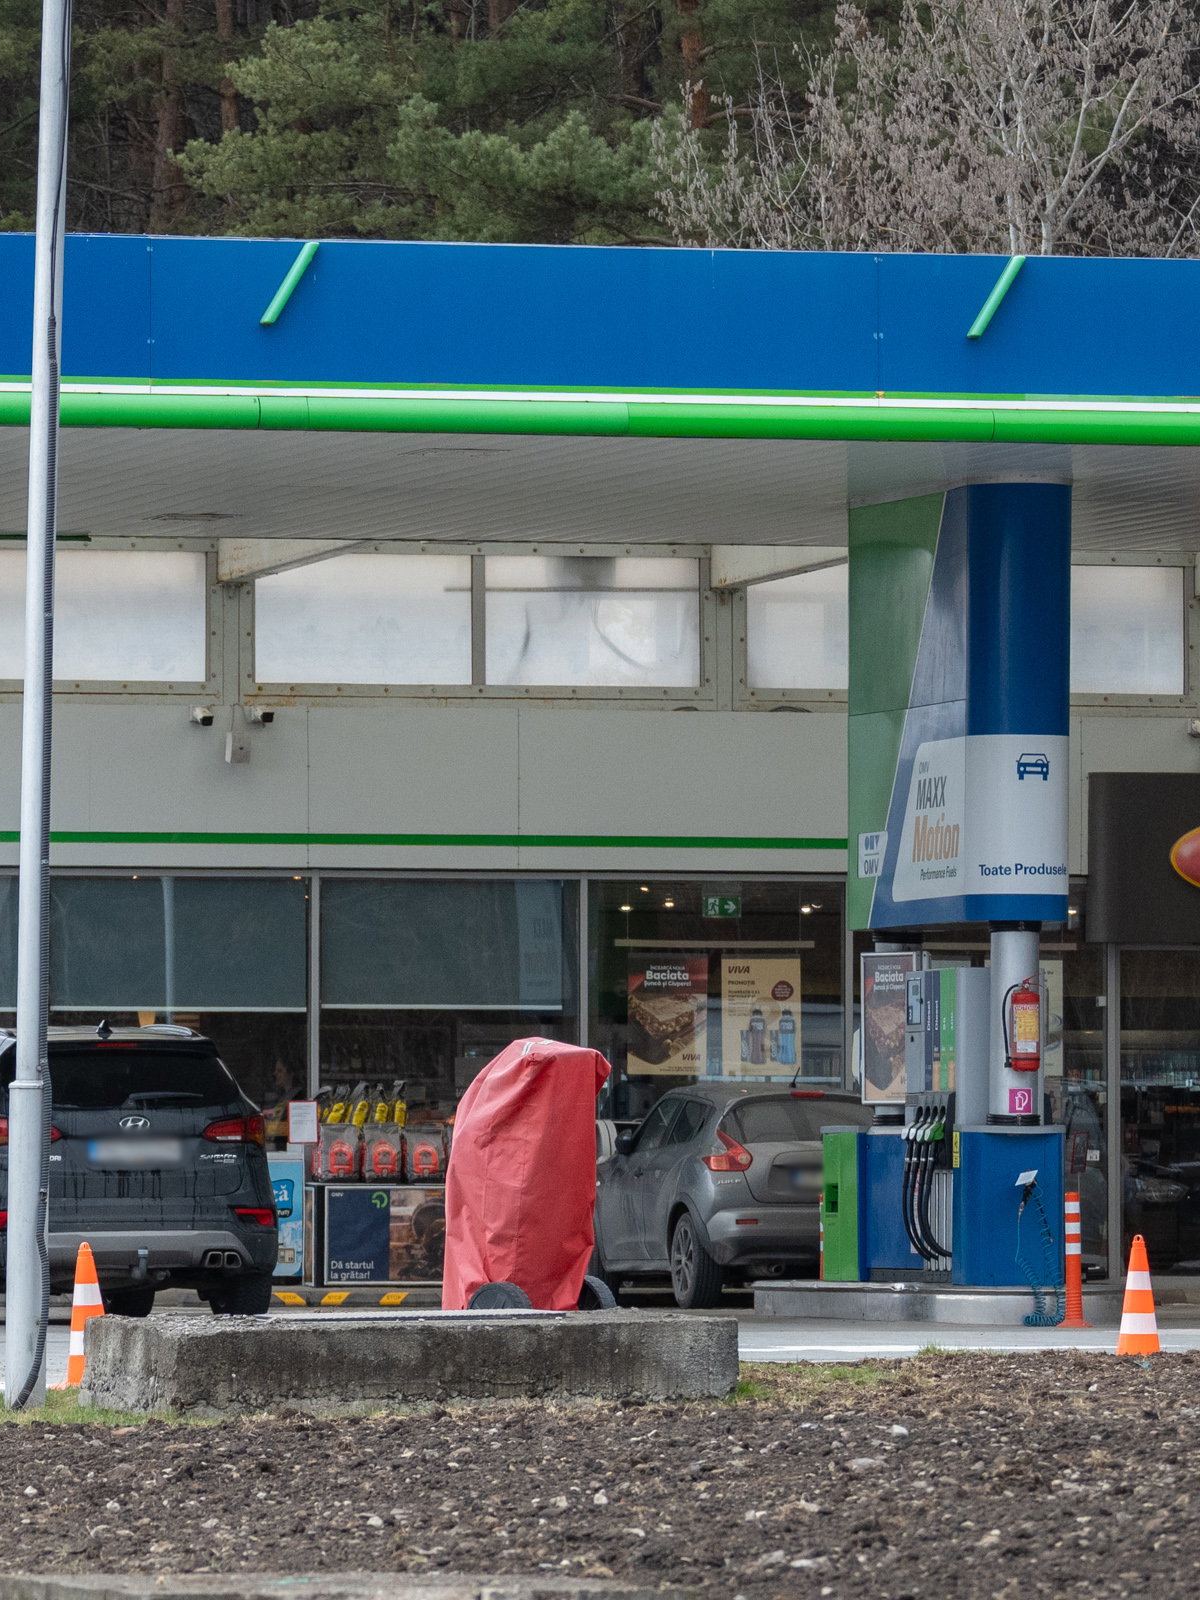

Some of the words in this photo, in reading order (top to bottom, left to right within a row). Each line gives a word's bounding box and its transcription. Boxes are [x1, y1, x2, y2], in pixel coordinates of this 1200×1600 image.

[919, 762, 929, 774] OMV
[916, 776, 947, 810] MAXX
[912, 813, 960, 862] Motion
[864, 857, 879, 875] OMV
[979, 864, 1011, 876] Toate
[1015, 863, 1067, 876] Produsele
[919, 867, 946, 881] Performance
[946, 865, 958, 878] Fuels
[646, 970, 689, 980] Baciata
[728, 965, 750, 974] VIVA
[875, 971, 903, 983] Baciata
[682, 1053, 701, 1061] VIVA
[331, 1260, 344, 1270] Dă
[345, 1260, 375, 1270] startul
[331, 1271, 339, 1279] la
[341, 1271, 370, 1280] grătar!
